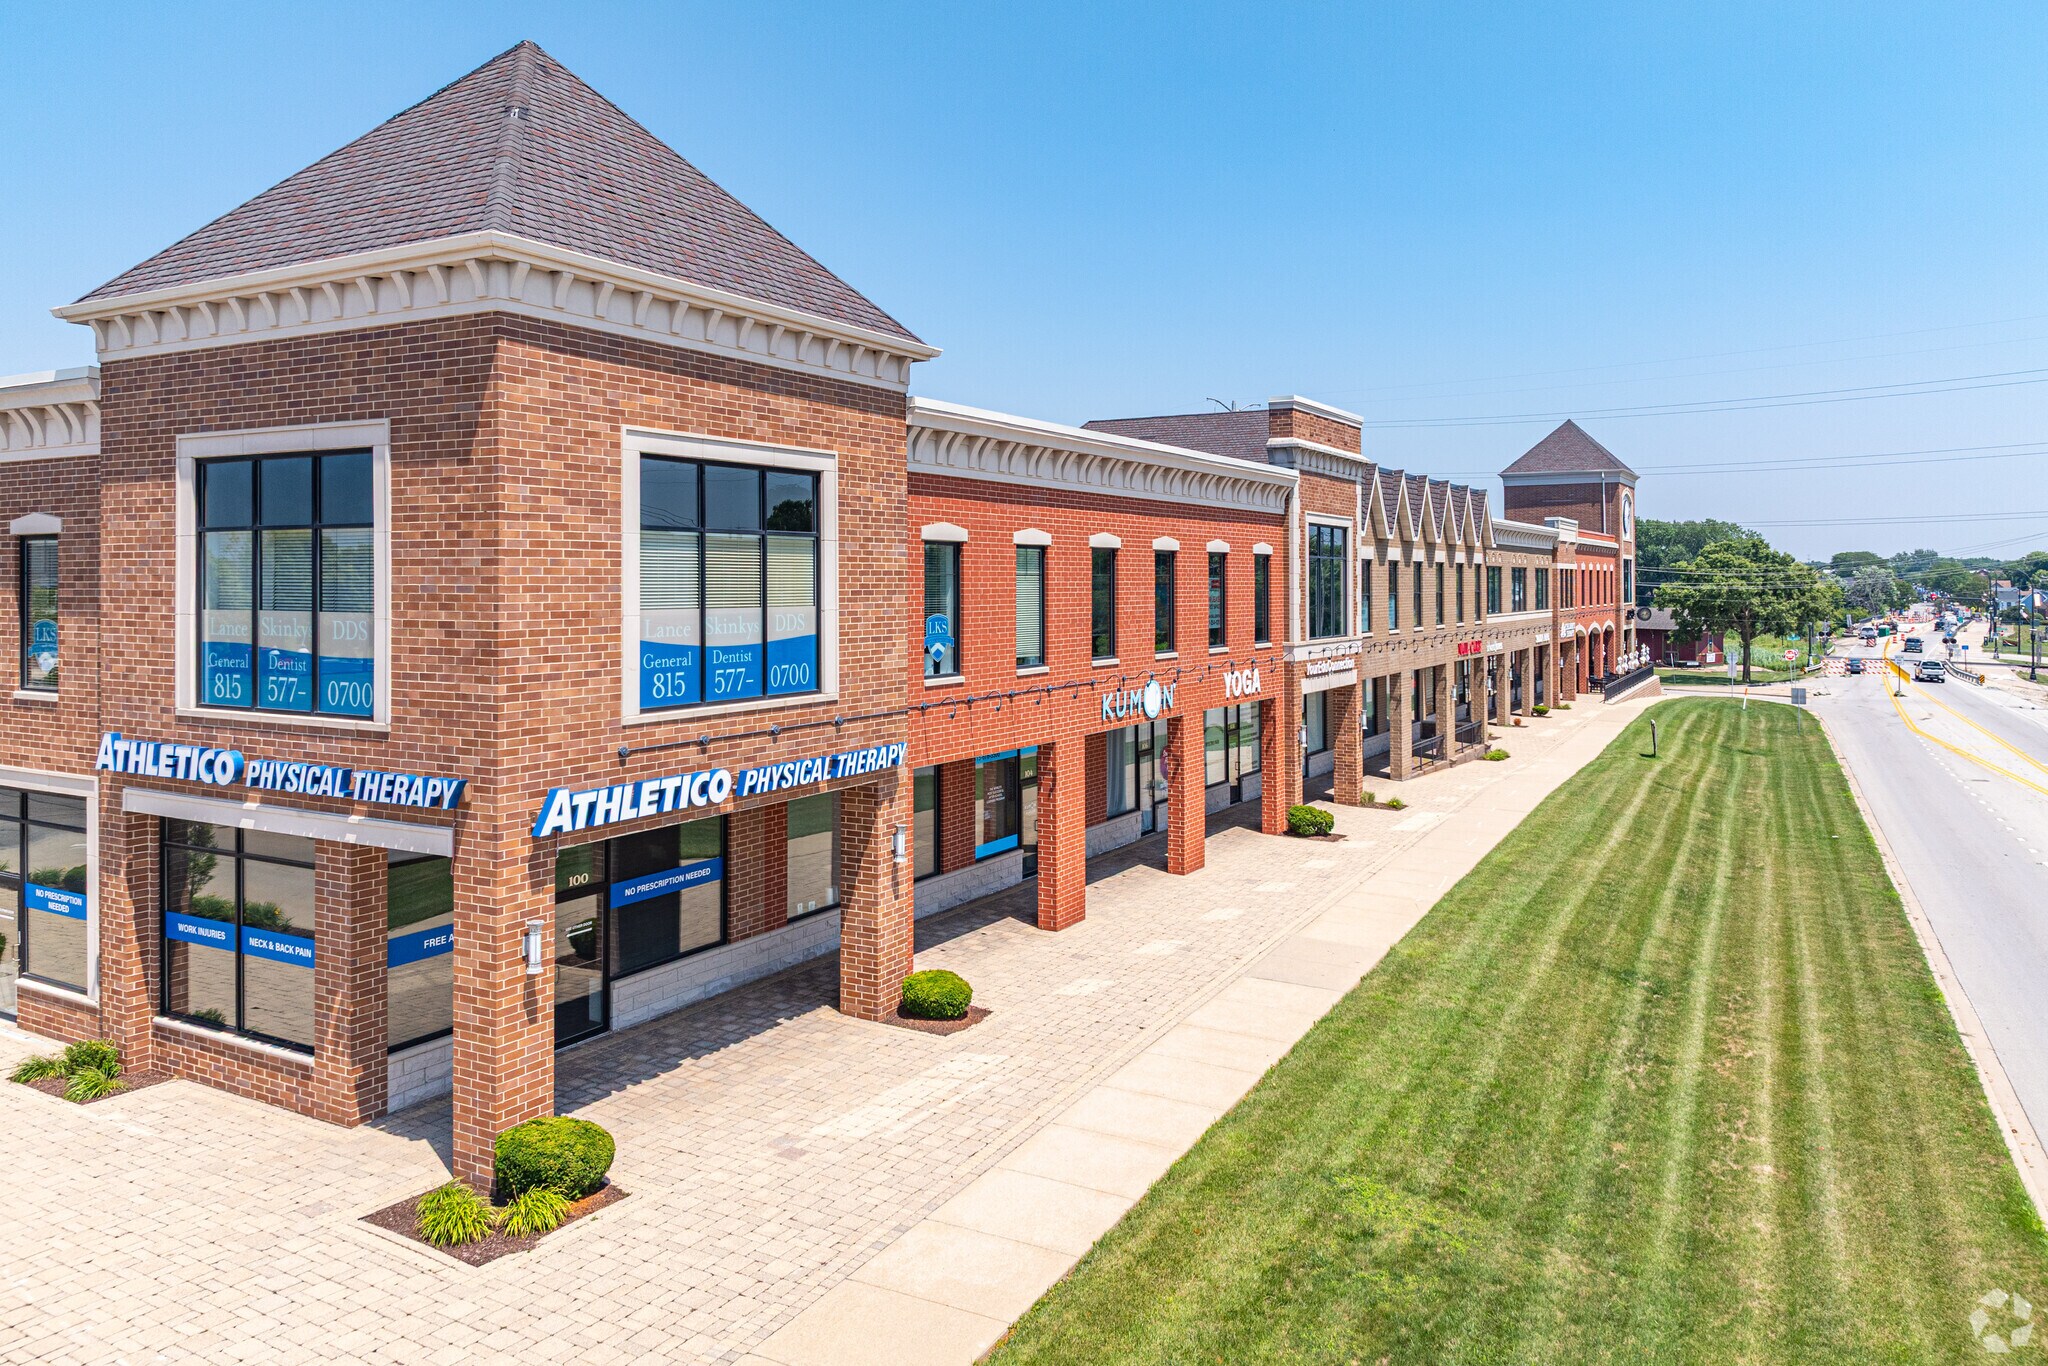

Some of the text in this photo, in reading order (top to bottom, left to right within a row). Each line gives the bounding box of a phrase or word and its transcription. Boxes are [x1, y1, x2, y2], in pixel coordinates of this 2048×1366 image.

[35, 627, 56, 642] LKS
[209, 617, 248, 637] Lance
[332, 620, 368, 641] DDS
[645, 613, 806, 640] Lance Skinkys DDS
[928, 621, 948, 635] LKS
[208, 652, 307, 672] General Dentist
[643, 649, 752, 669] General Dentist
[214, 673, 373, 708] 815 577- 0700
[652, 662, 810, 699] 815 577- 0700
[1222, 668, 1261, 698] YOGA
[1102, 680, 1174, 721] KUMON
[95, 732, 462, 810] ATHLETICO PHYSICAL THERAPY
[535, 742, 908, 838] ATHLETICO PHYSICAL THERAPY
[568, 873, 589, 888] 100
[624, 867, 711, 896] NO PRESCRIPTION NEEDED
[35, 888, 82, 906] NO PRESCRIPTION
[48, 901, 70, 913] NEEDED
[178, 922, 226, 940] WORK INJURIES
[249, 937, 312, 958] NECK & BACK PAIN
[423, 935, 447, 949] FREE
